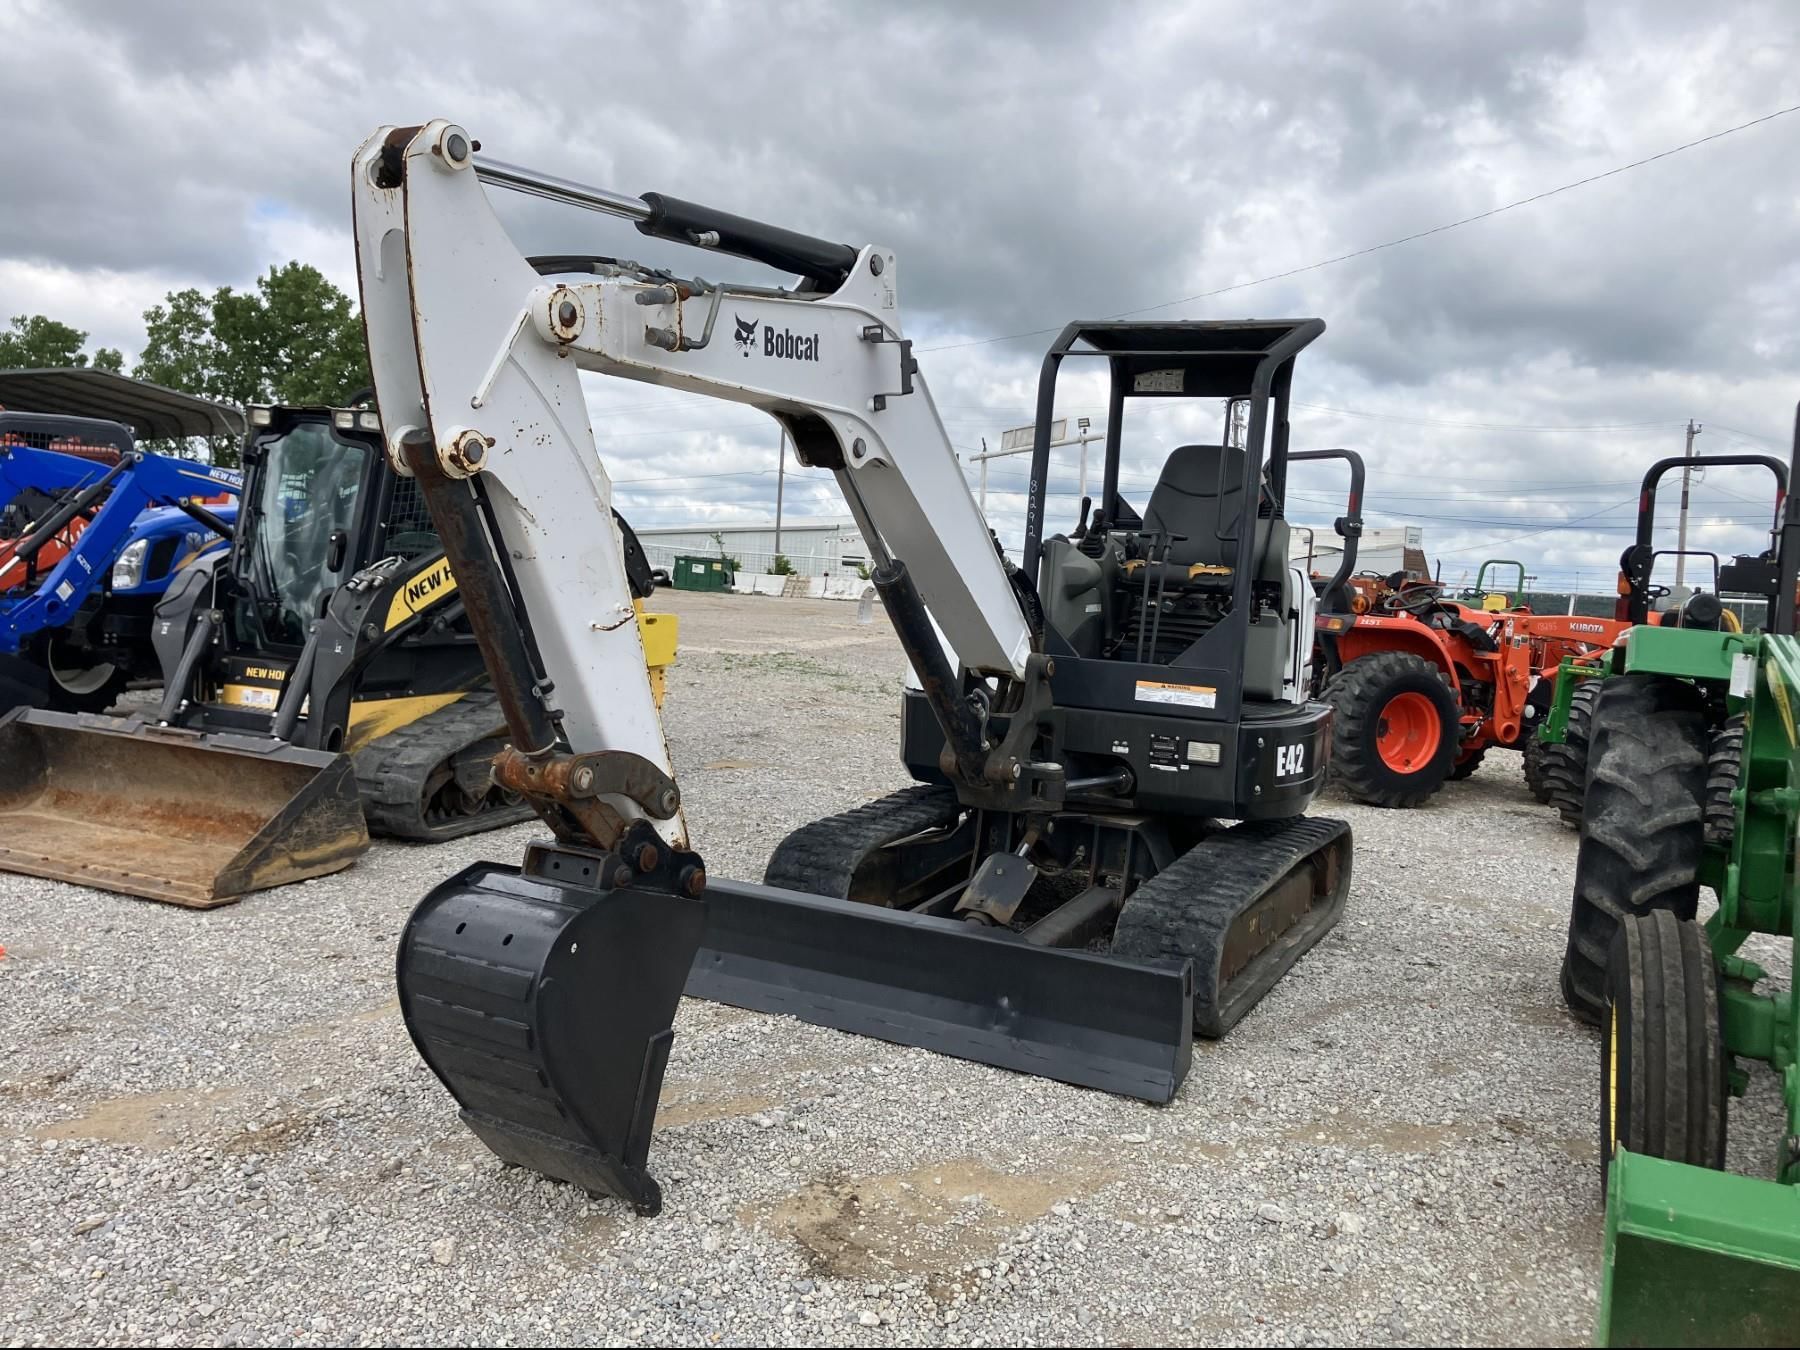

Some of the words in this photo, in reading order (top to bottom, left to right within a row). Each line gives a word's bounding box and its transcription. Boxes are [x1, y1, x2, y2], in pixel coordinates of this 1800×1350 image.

[764, 326, 819, 361] Bobcat
[209, 469, 228, 481] NEW
[408, 570, 441, 603] NEW
[1569, 622, 1604, 633] KUBOTA
[246, 666, 267, 679] NEW
[1276, 743, 1304, 777] E42
